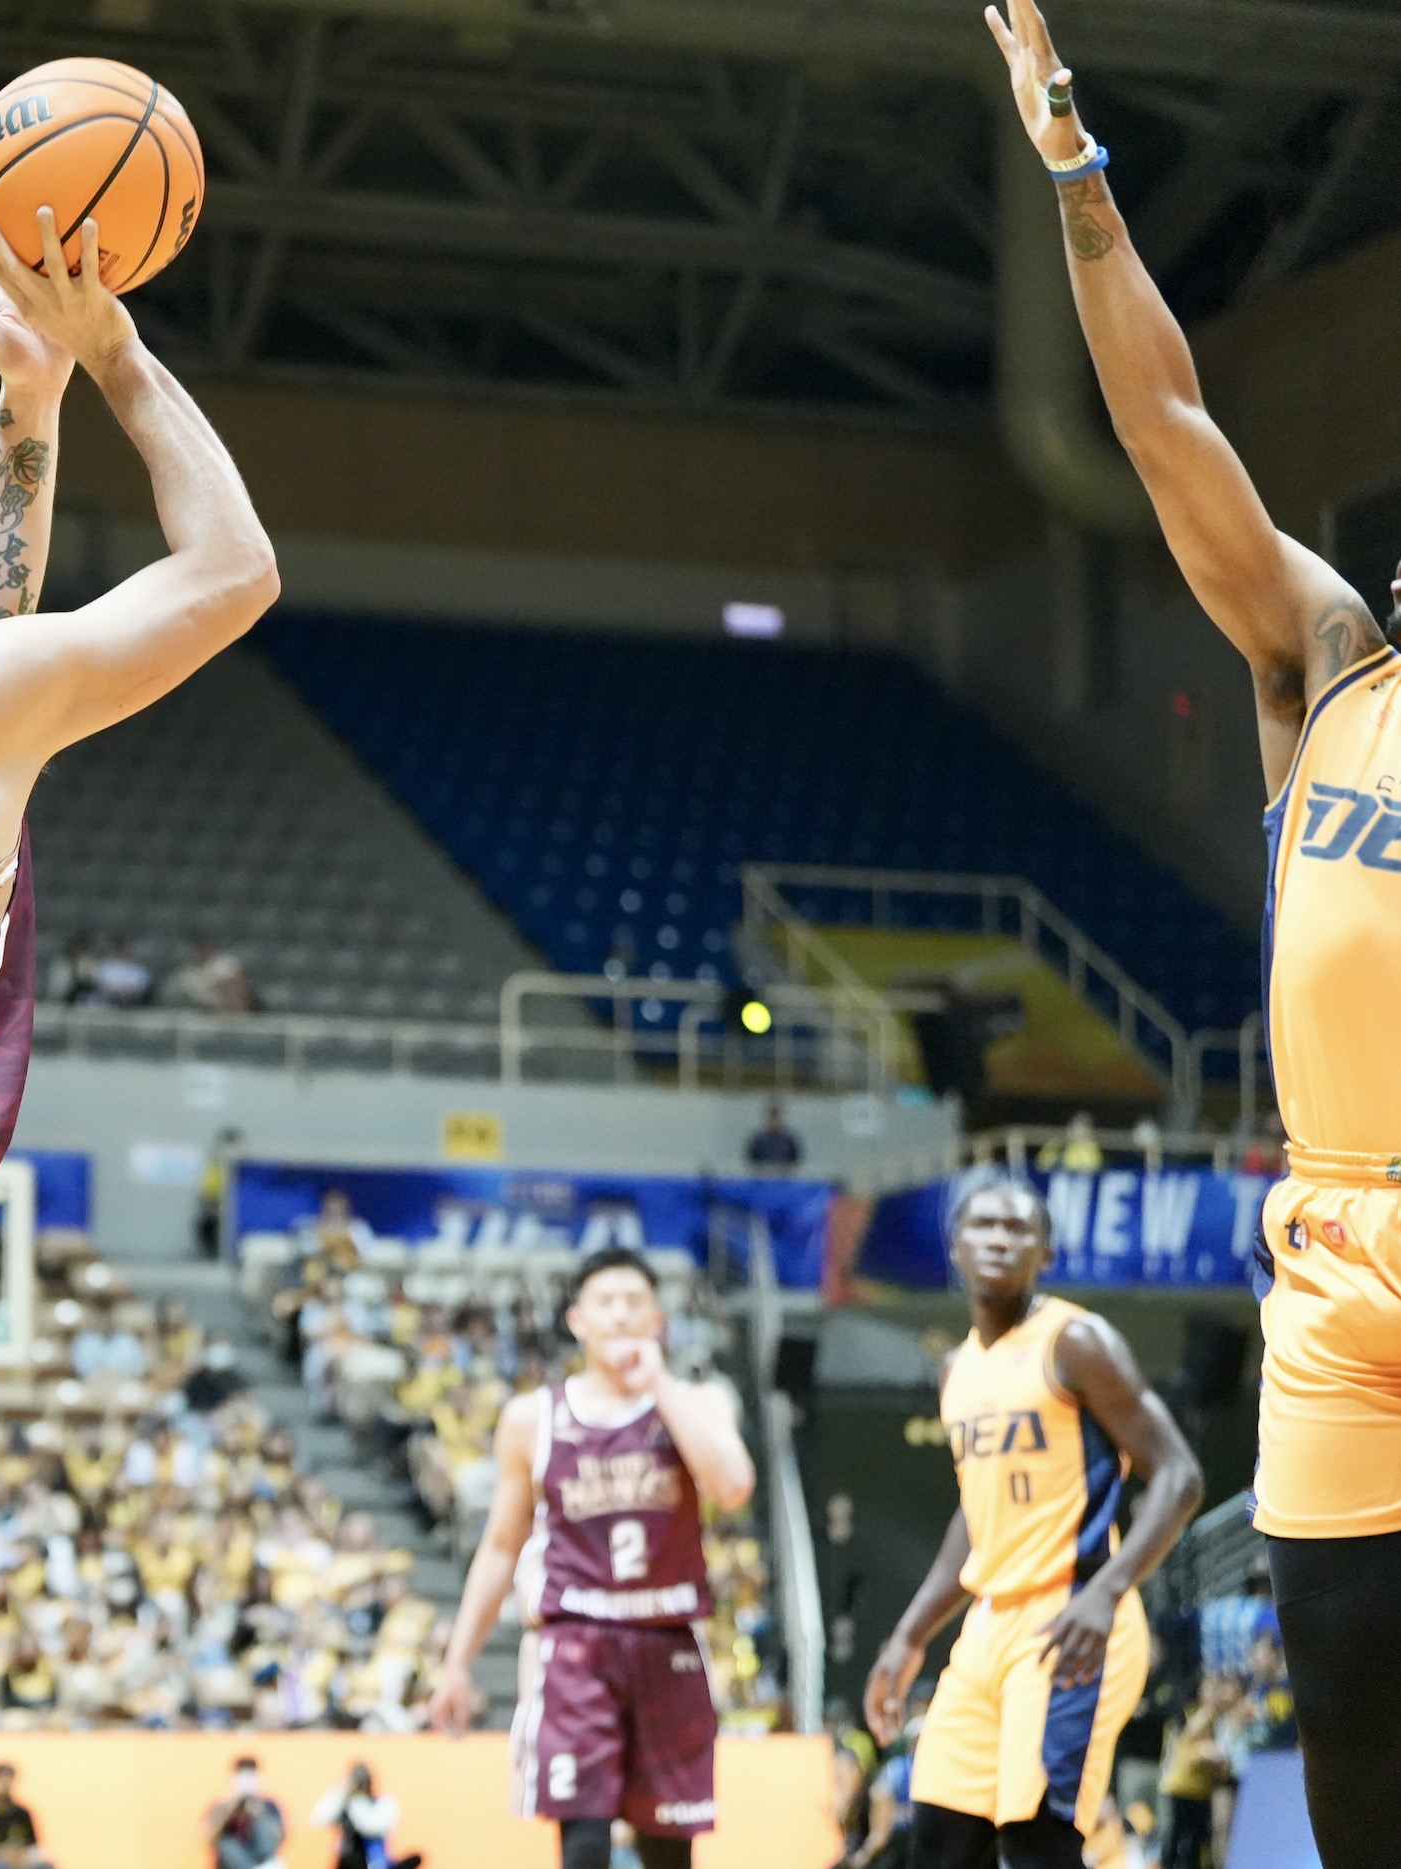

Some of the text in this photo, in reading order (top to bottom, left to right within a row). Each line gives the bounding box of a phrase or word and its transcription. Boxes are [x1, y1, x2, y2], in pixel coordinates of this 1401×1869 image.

[1300, 781, 1401, 872] DE
[1045, 1168, 1200, 1259] NEW
[609, 1517, 648, 1583] 2
[548, 1752, 578, 1801] 2
